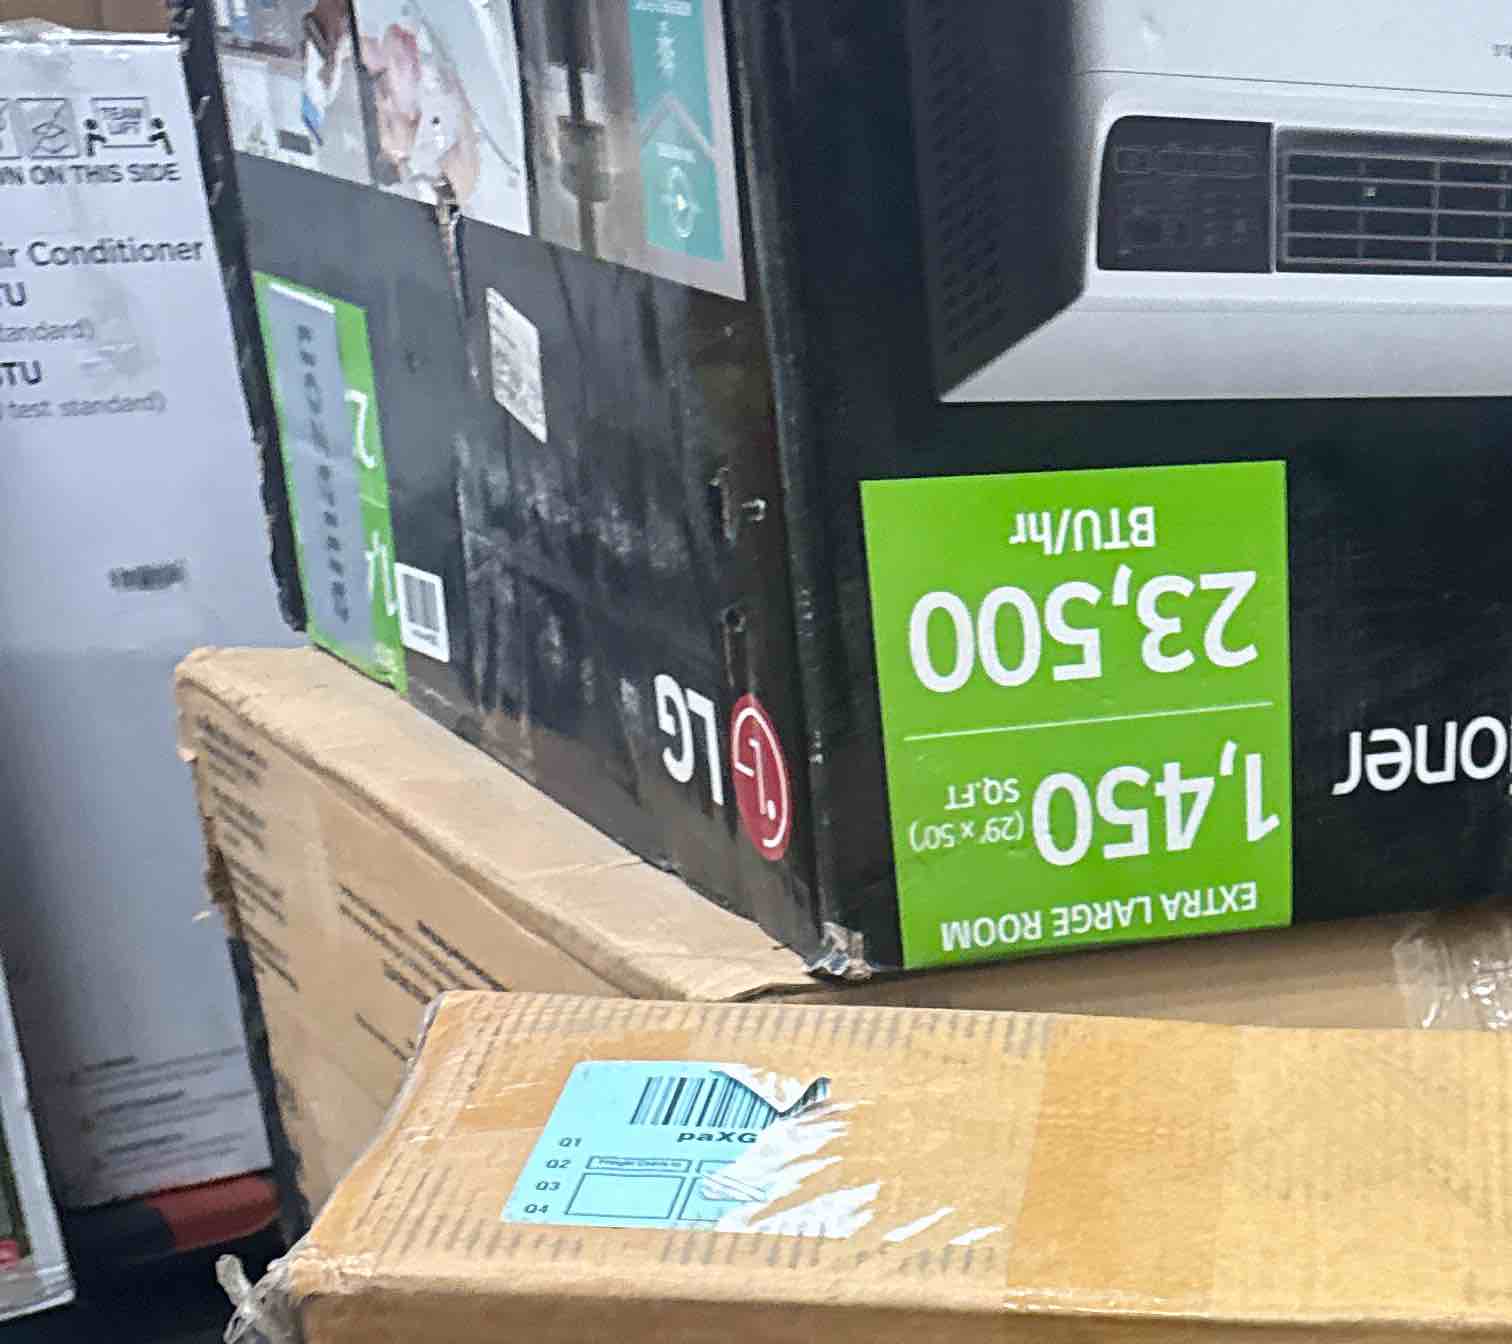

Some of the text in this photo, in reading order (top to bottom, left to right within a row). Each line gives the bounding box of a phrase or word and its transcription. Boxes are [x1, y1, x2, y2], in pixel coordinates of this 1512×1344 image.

[30, 165, 65, 185] ON
[69, 164, 122, 184] THIS
[128, 162, 181, 182] SIDE
[28, 236, 203, 266] Conditioner
[0, 360, 42, 386] TU
[1011, 506, 1155, 555] BTU/hr
[909, 564, 1257, 693] 23,500
[654, 674, 723, 806] LG
[944, 777, 1020, 810] SQ.FT
[1032, 742, 1280, 866] 1,450
[940, 883, 1256, 951] EXTRA LARGE ROOM
[559, 1137, 581, 1148] Q1
[546, 1159, 571, 1170] Q2
[535, 1181, 561, 1192] Q3
[524, 1203, 549, 1215] Q4
